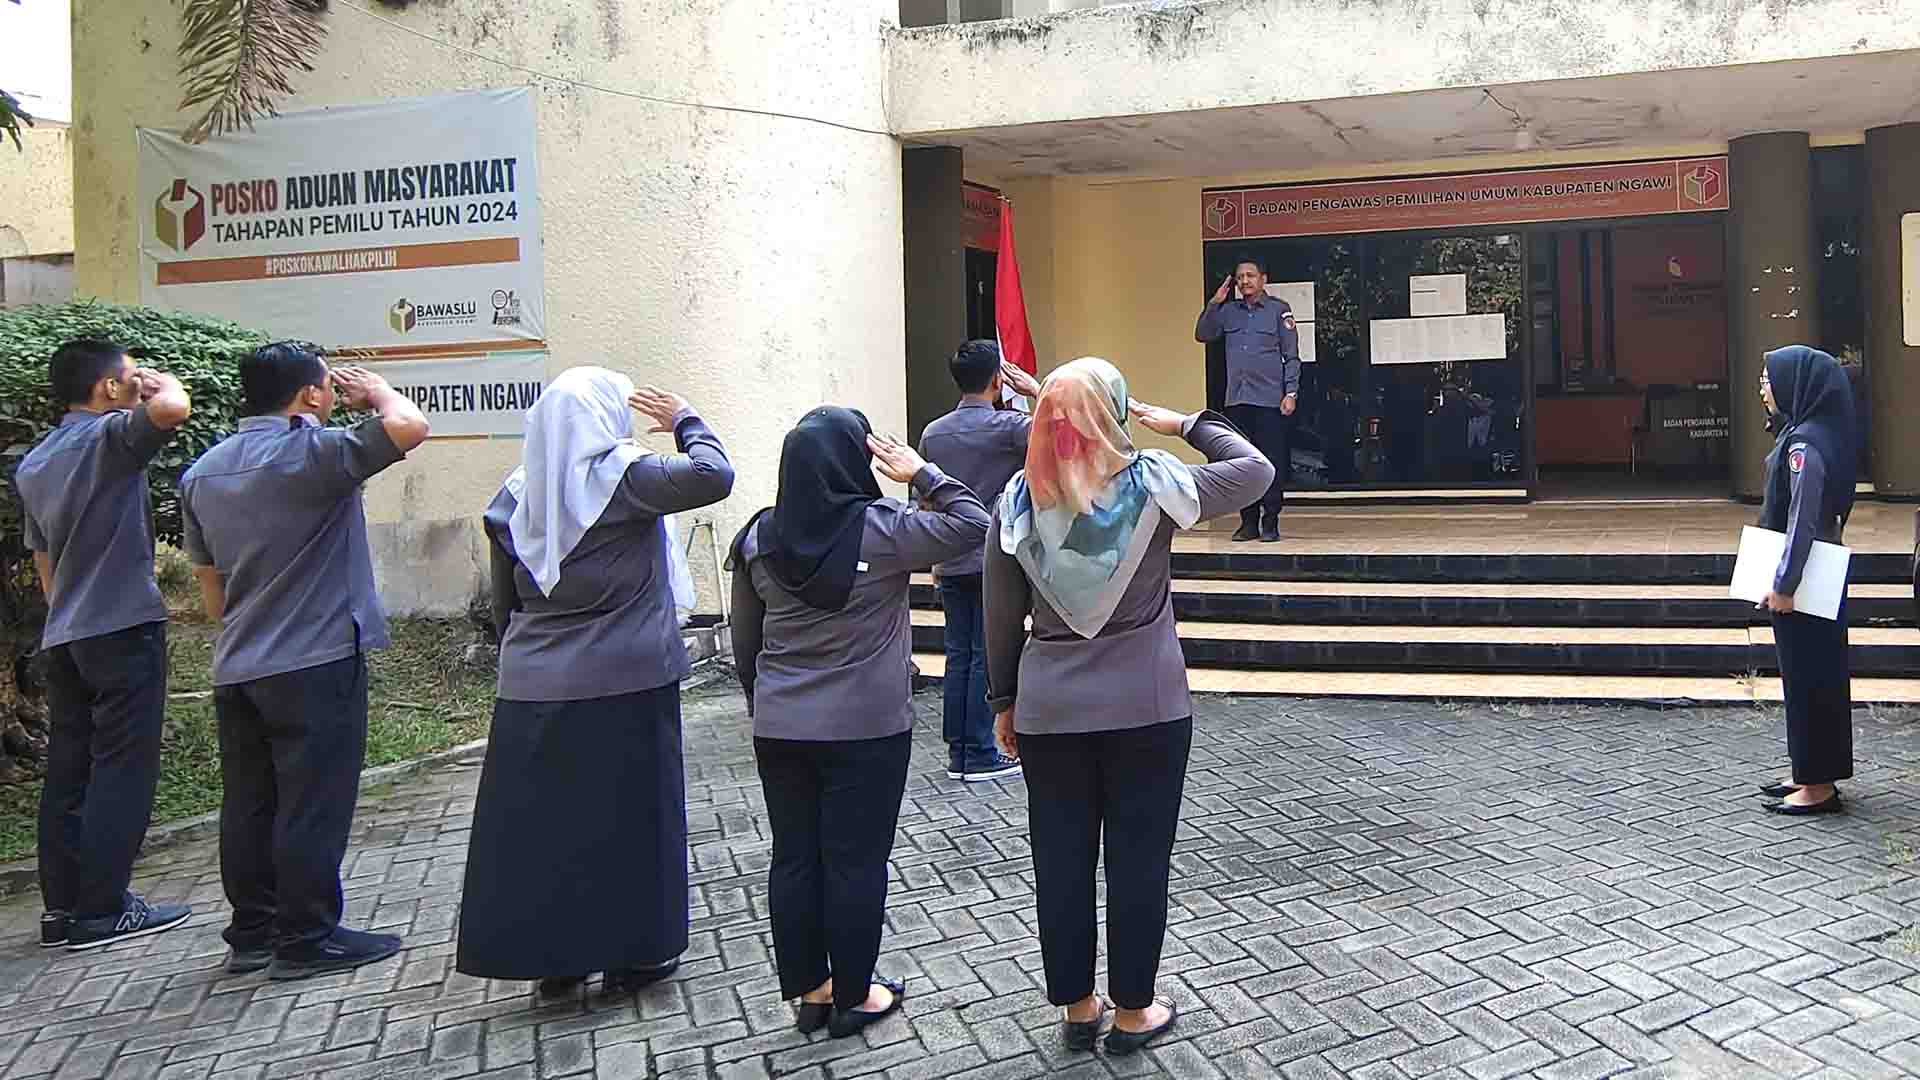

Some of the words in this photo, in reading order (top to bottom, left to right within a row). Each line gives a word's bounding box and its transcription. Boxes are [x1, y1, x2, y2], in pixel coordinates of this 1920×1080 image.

[211, 178, 278, 216] POSKO
[285, 171, 357, 210] ADUAN
[364, 157, 517, 204] MASYARAKAT
[1249, 200, 1297, 215] BADAN
[1302, 196, 1381, 210] PENGAWAS
[1386, 190, 1465, 206] PEMILIHAN
[1471, 186, 1518, 200] UMUM
[1523, 179, 1614, 197] KABUPATEN
[1619, 175, 1671, 191] NGAWI
[212, 217, 304, 243] TAHAPAN
[309, 209, 384, 236] PEMILU
[388, 204, 460, 231] TAHUN
[466, 199, 518, 224] 2024
[417, 301, 476, 318] BAWASLU
